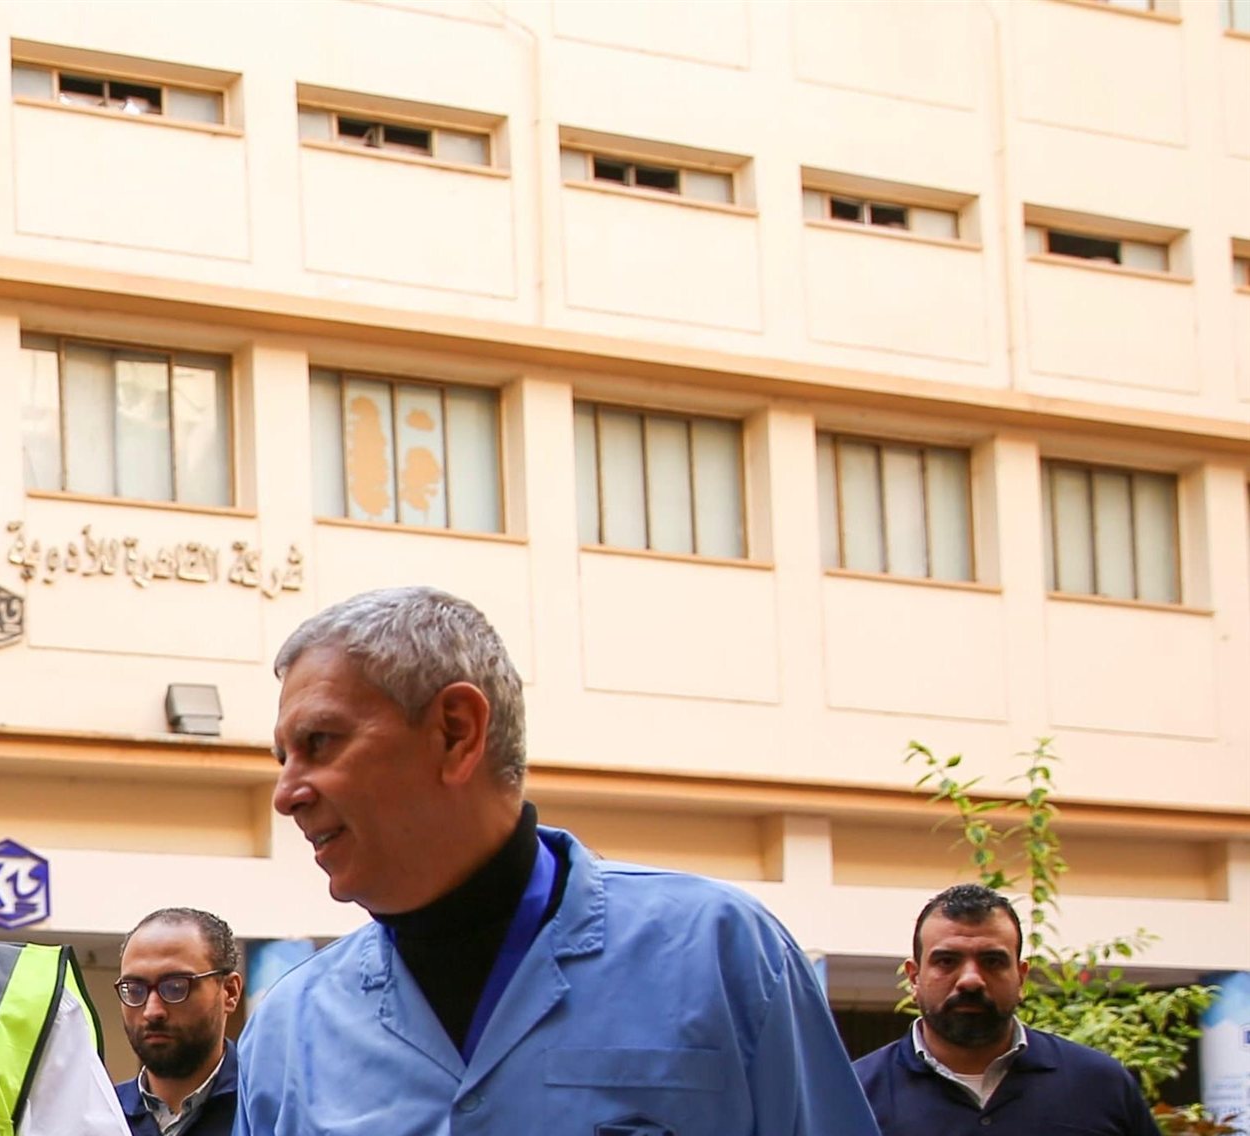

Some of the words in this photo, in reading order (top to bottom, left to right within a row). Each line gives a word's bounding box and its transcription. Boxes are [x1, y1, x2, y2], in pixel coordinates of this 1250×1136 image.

[6, 521, 119, 585] للأدوية
[123, 537, 219, 588] القاهرة
[228, 541, 302, 599] شركة
